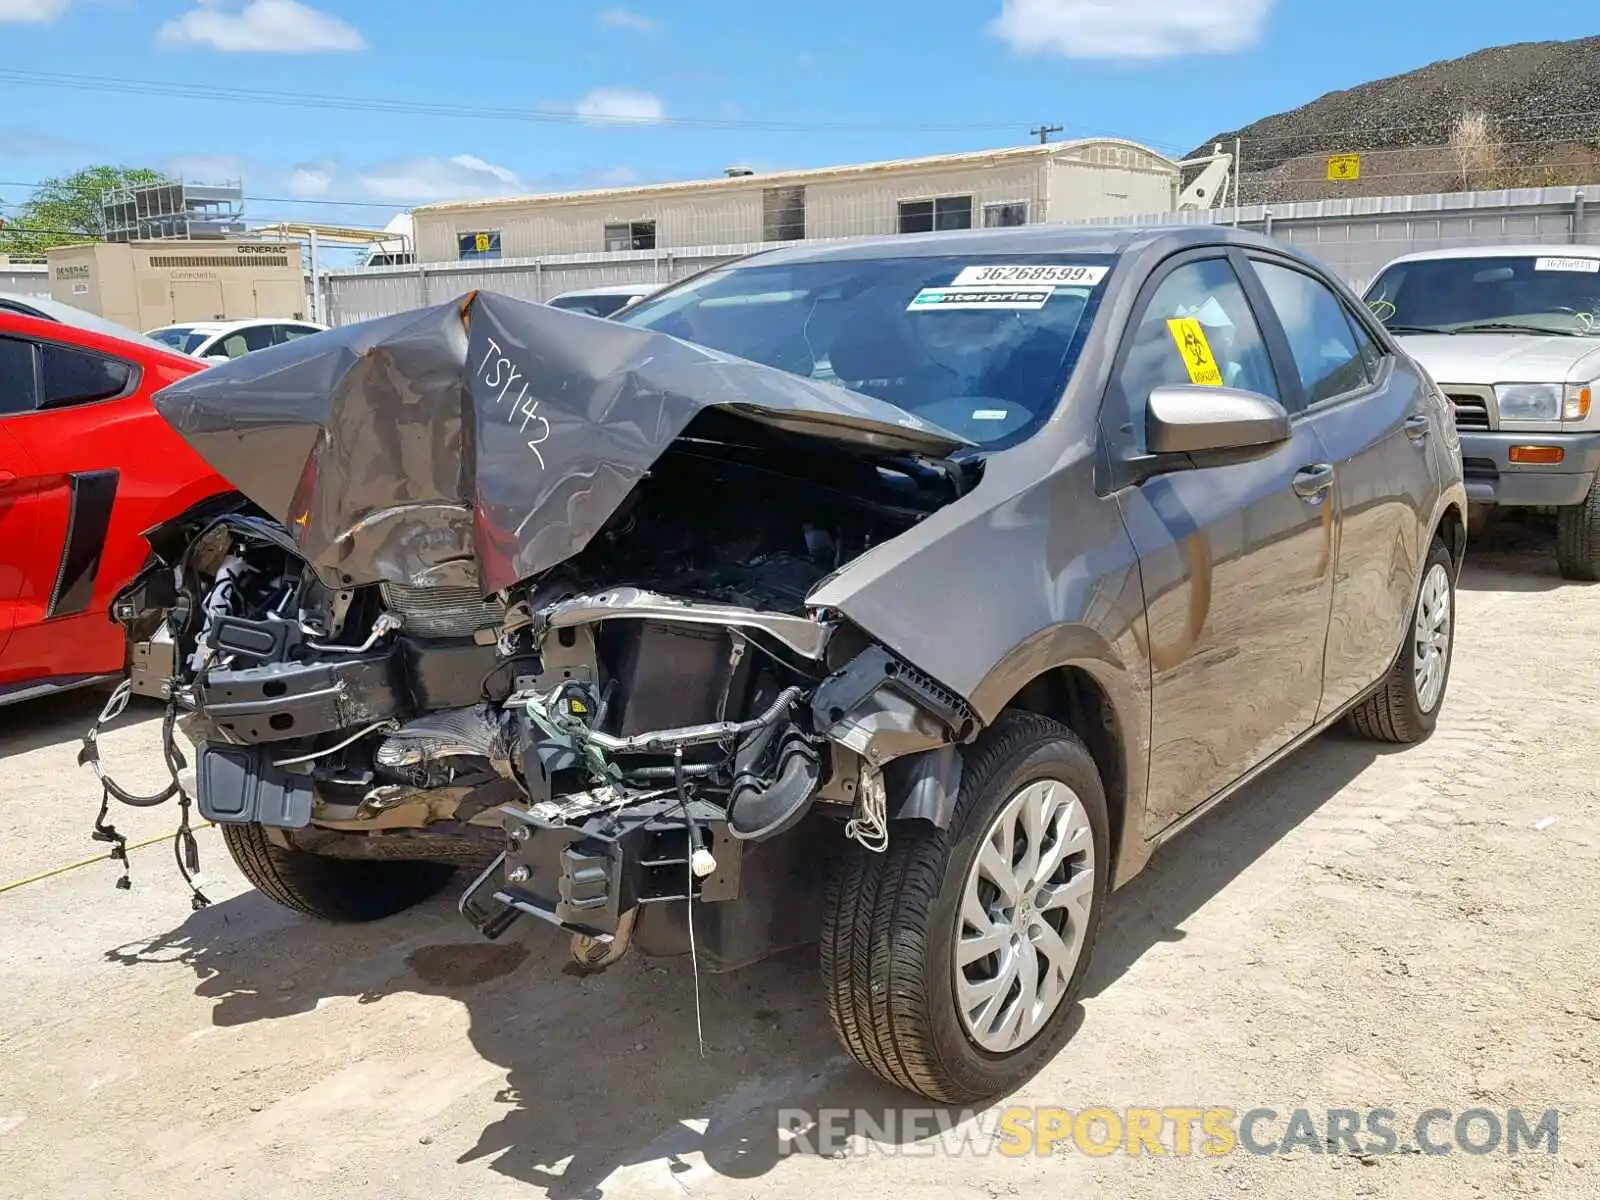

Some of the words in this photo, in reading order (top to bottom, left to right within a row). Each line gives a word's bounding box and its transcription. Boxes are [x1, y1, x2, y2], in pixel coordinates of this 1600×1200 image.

[237, 245, 287, 254] GENERAC
[916, 291, 1046, 304] enterprise
[476, 337, 550, 471] TSY142
